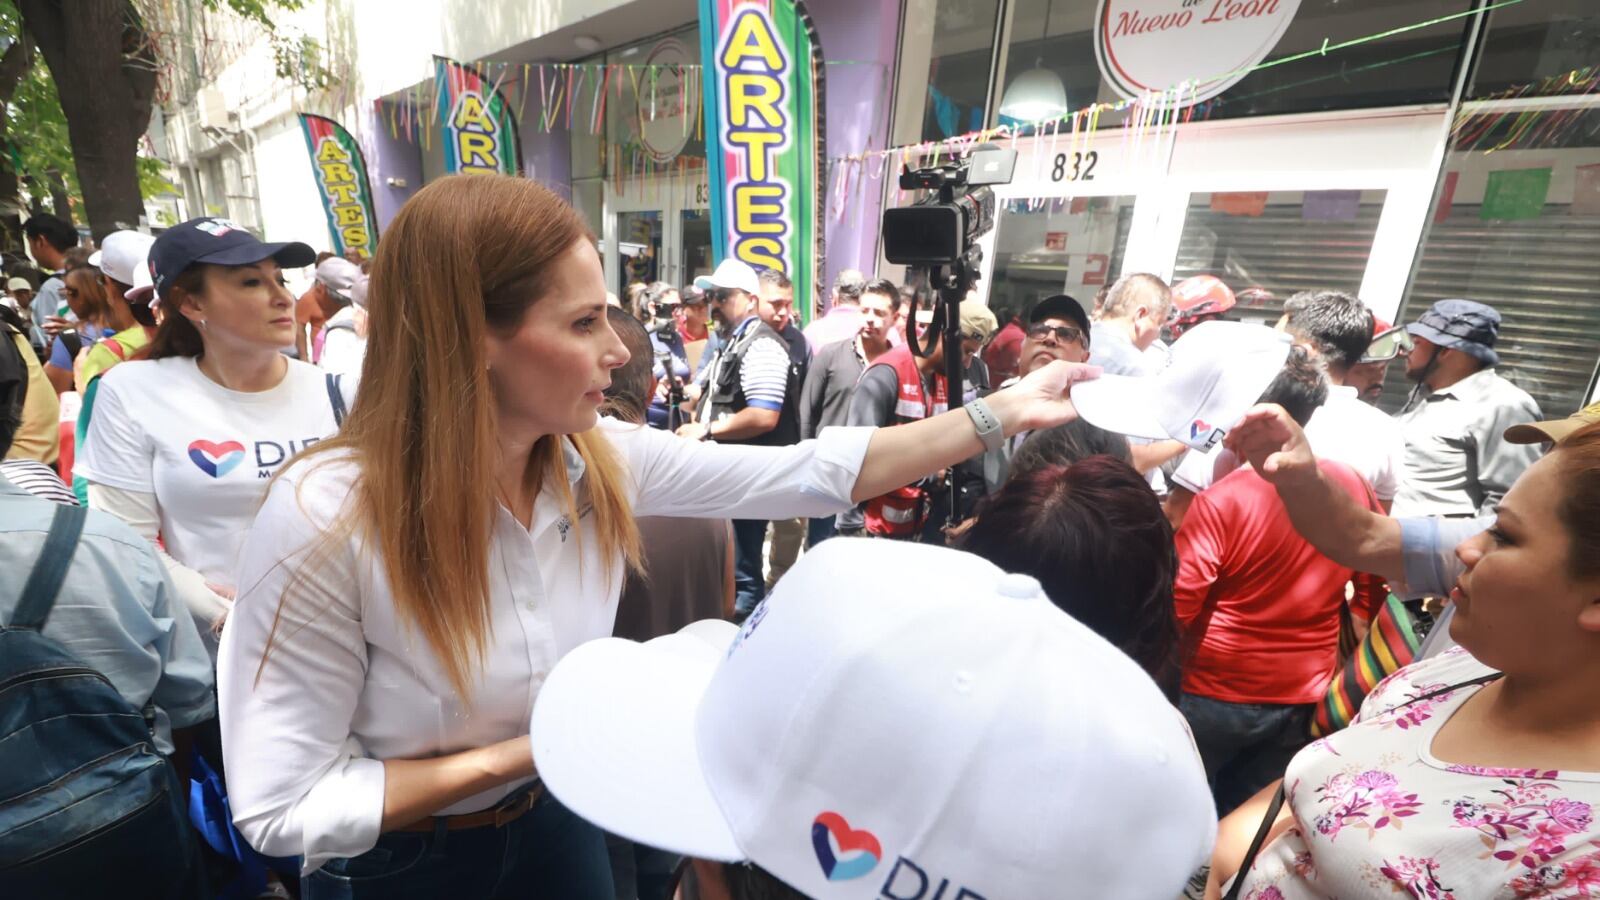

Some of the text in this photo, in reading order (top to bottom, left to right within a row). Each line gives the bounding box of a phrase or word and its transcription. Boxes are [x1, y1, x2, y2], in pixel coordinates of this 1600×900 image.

[1112, 10, 1193, 38] Nuevo
[454, 93, 500, 175] AR
[721, 9, 788, 275] ARTES
[1051, 151, 1098, 182] 832
